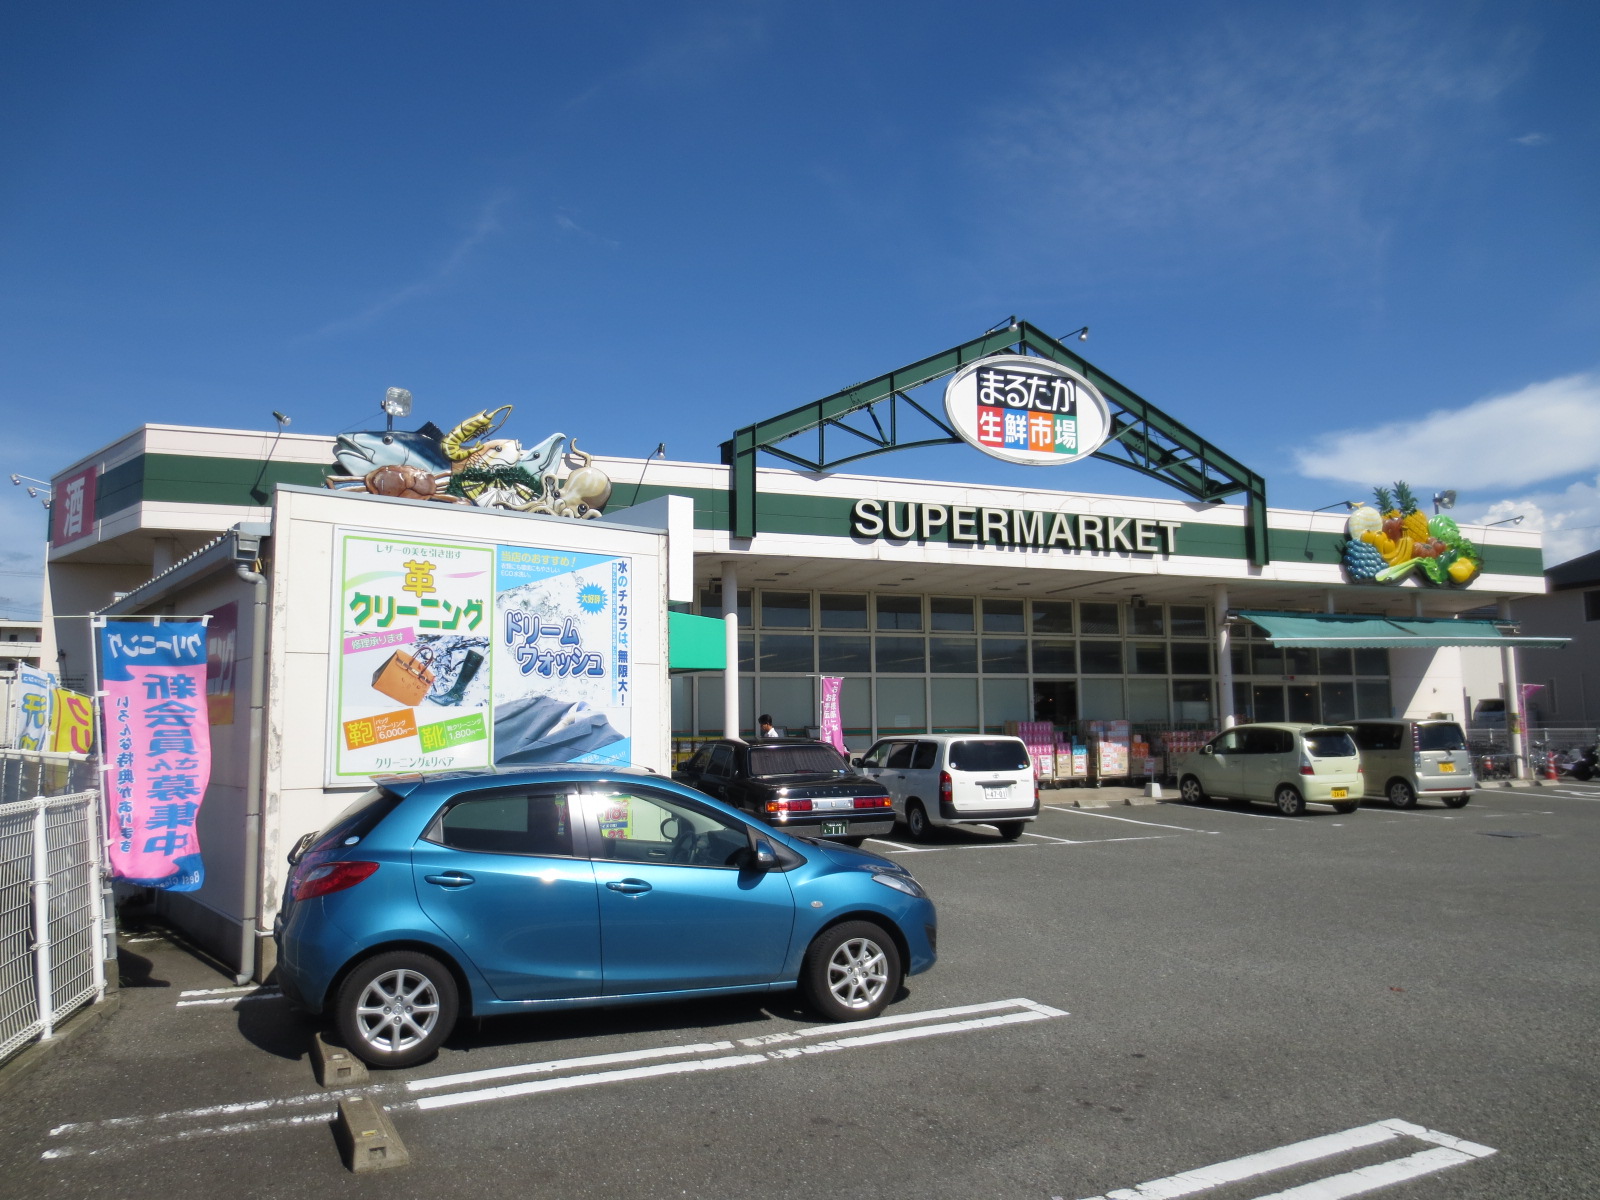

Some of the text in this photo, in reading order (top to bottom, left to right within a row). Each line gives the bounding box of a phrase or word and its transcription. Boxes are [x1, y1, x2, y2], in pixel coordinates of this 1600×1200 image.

[980, 371, 1074, 412] まるたか
[979, 411, 1076, 449] 生鮮市場
[63, 476, 86, 537] 酒
[855, 499, 1181, 553] SUPERMARKET
[376, 544, 461, 559] レザーの美を引き出す
[402, 559, 437, 598] 革
[350, 592, 483, 631] クリーニング
[506, 611, 580, 646] ドリーム
[352, 633, 404, 650] 修理承ります
[516, 643, 604, 677] ウォッシュ
[347, 721, 375, 747] 鞄
[421, 724, 446, 749] 靴
